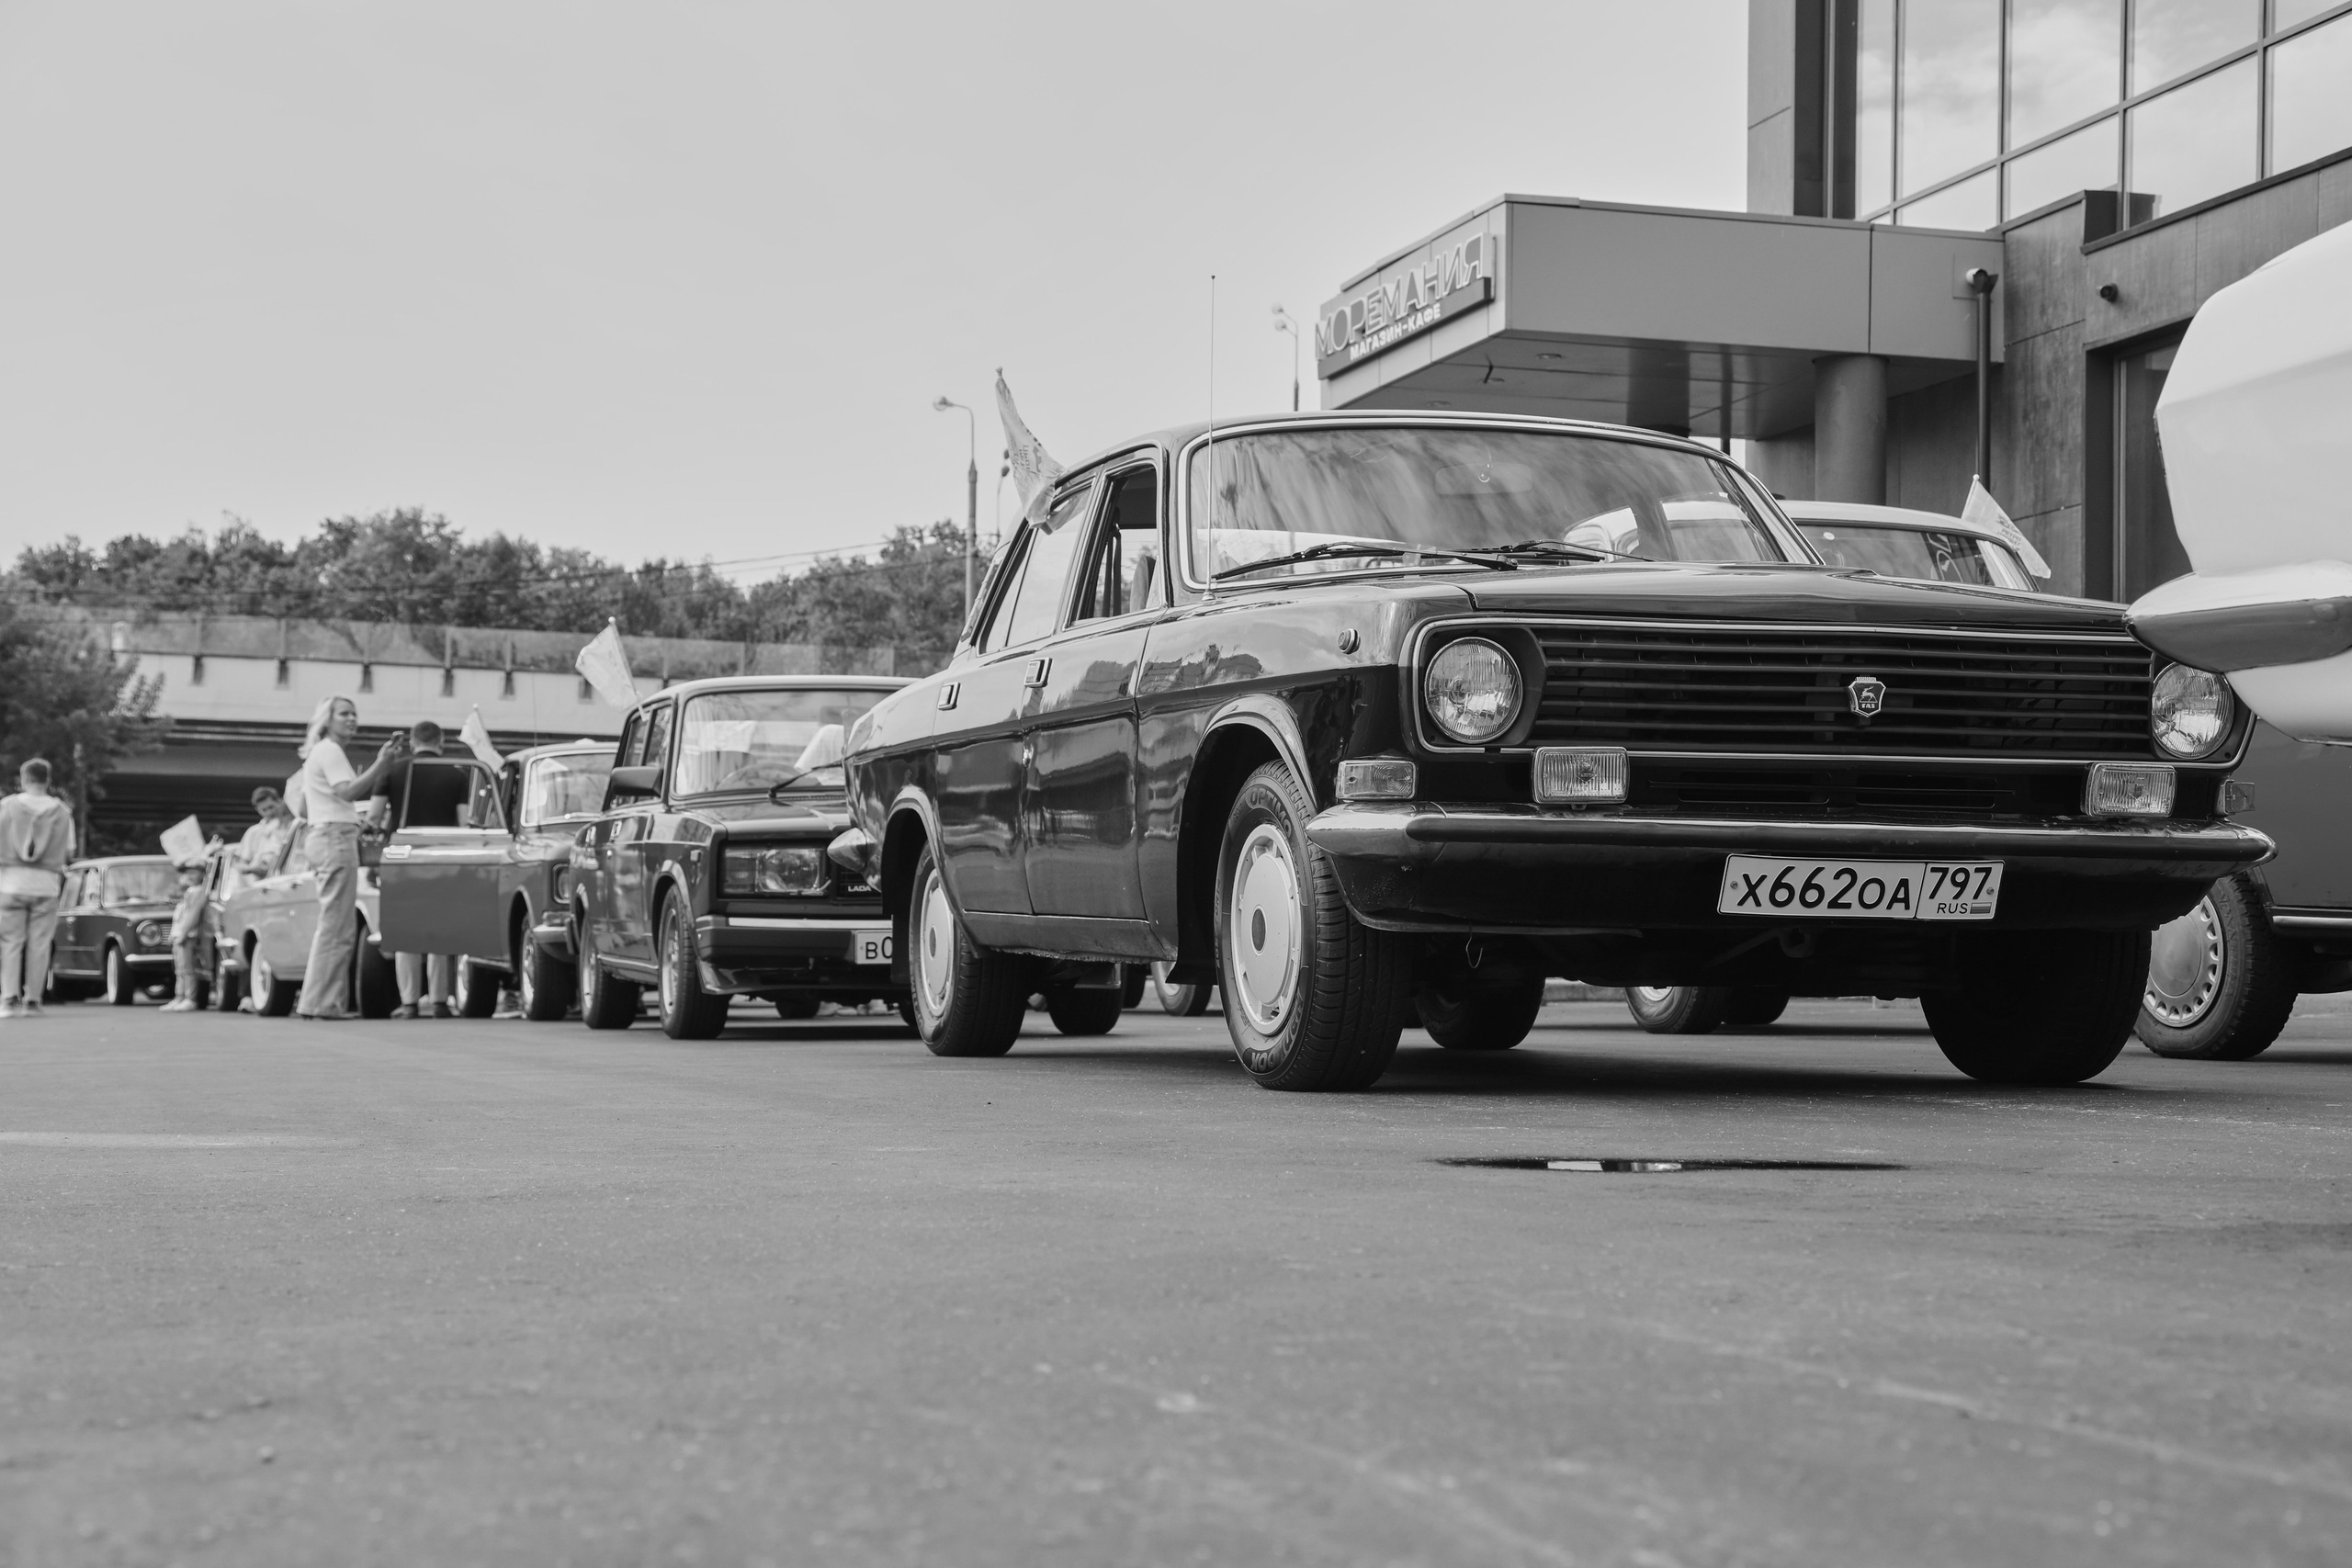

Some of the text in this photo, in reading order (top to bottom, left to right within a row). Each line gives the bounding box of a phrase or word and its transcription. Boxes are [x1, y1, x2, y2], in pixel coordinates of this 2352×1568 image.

[1315, 232, 1485, 360] МОРЕМАНИЯ
[1350, 303, 1442, 360] МАГАЗИН-КАФЕ
[1250, 787, 1292, 839] OPTIMO
[1928, 866, 1993, 900] 797
[1936, 902, 1969, 914] RUS
